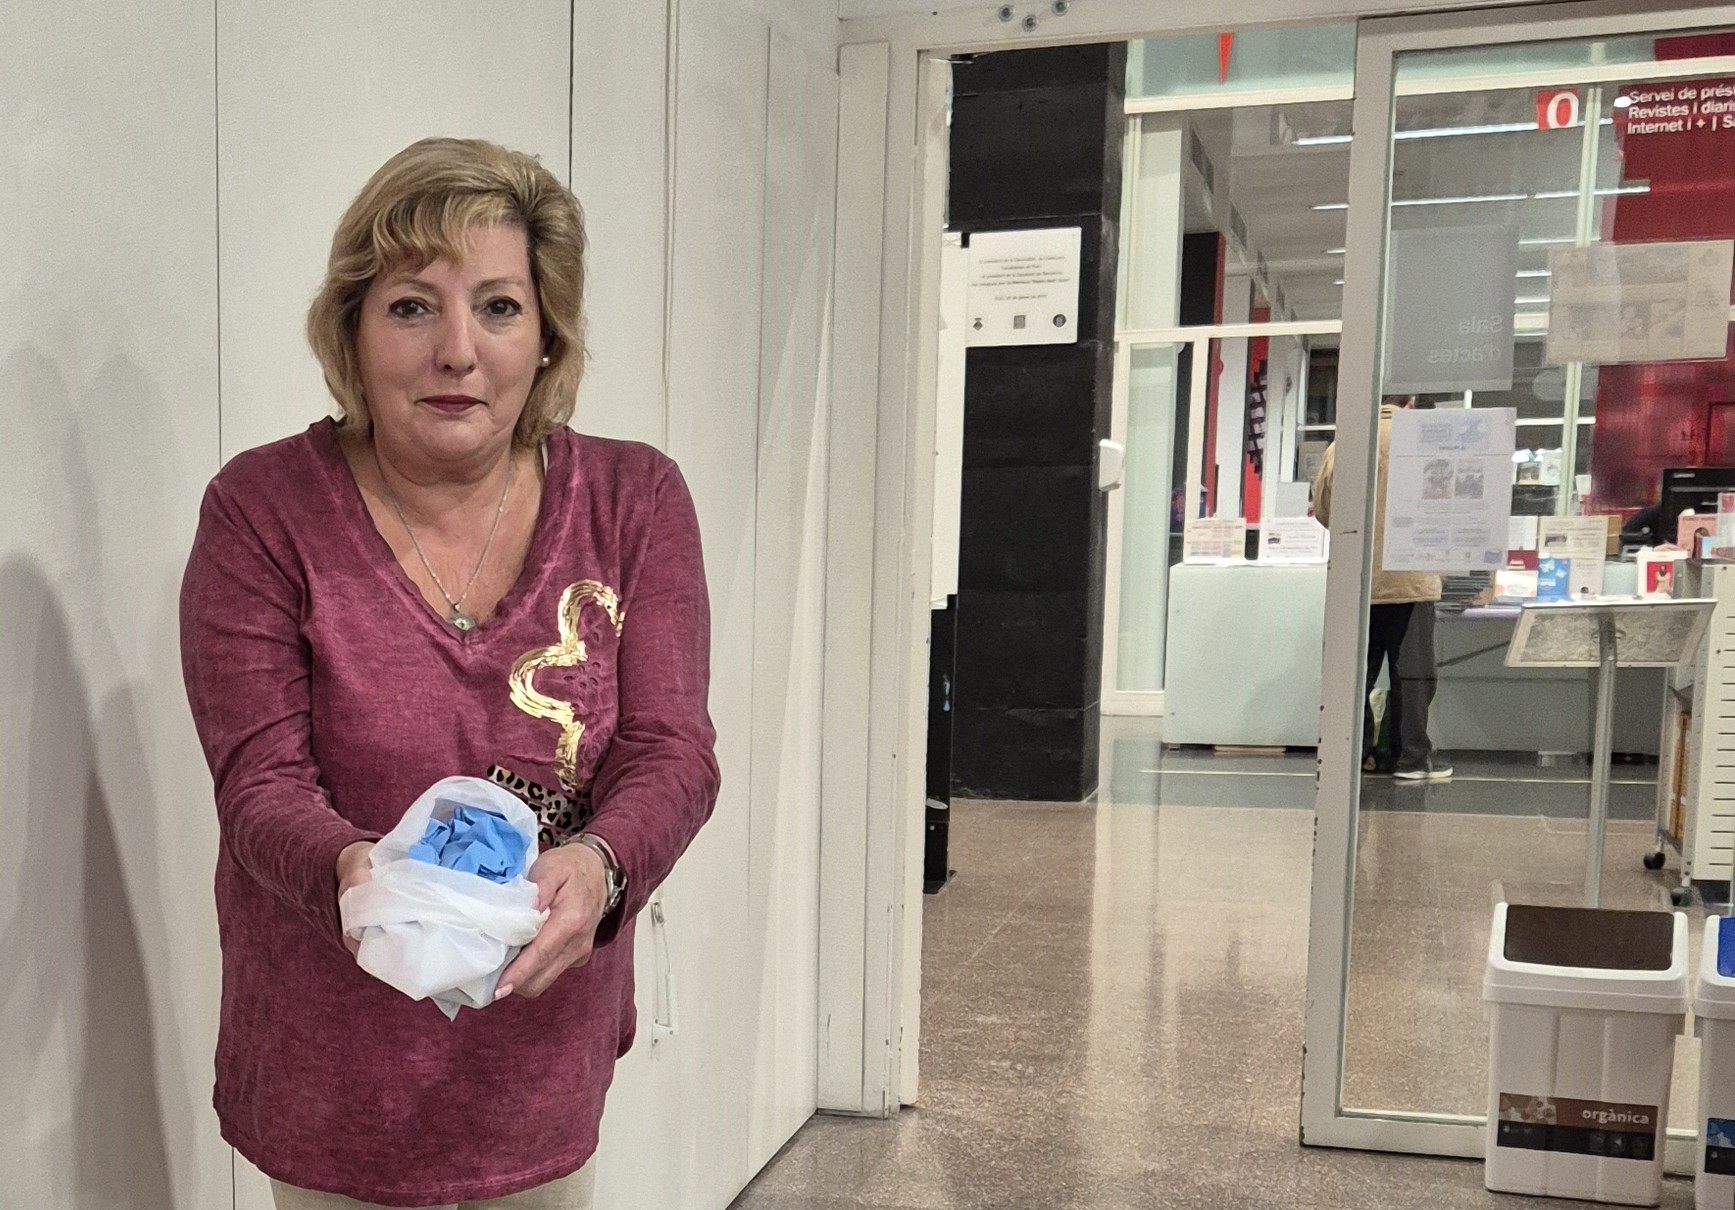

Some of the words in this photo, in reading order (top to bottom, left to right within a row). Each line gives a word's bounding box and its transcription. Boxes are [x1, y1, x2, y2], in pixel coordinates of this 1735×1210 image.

[1630, 88, 1674, 104] Servei
[1678, 86, 1697, 100] de
[1628, 104, 1689, 119] Revistes
[1627, 120, 1684, 134] Internet
[1582, 1108, 1649, 1124] orgànica
